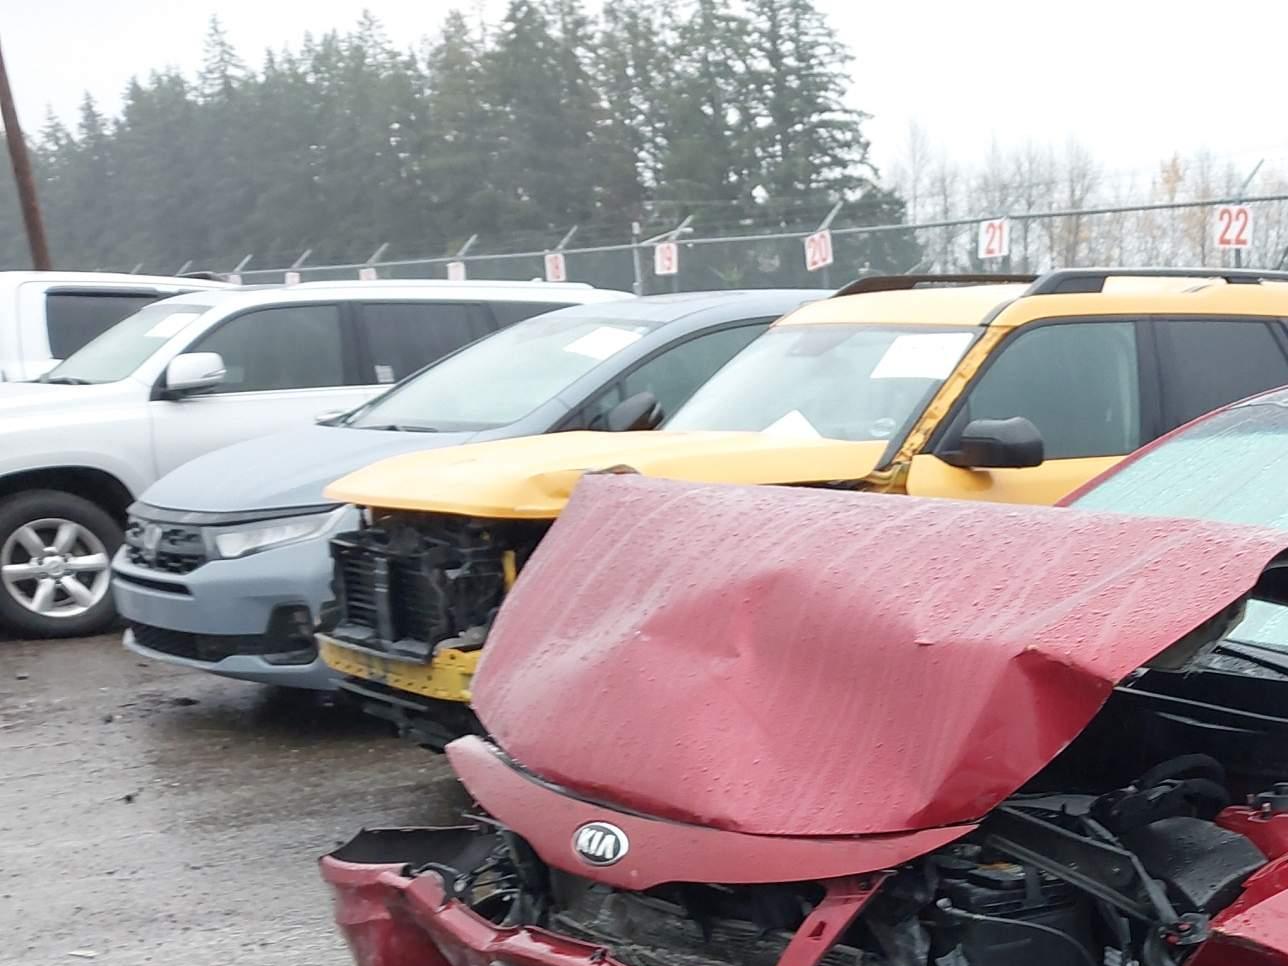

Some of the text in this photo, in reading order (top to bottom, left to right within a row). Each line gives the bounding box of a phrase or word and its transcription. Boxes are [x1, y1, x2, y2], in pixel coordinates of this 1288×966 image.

[985, 222, 1004, 256] 21
[1217, 207, 1249, 249] 22
[807, 233, 829, 267] 20
[576, 827, 616, 859] KIA
